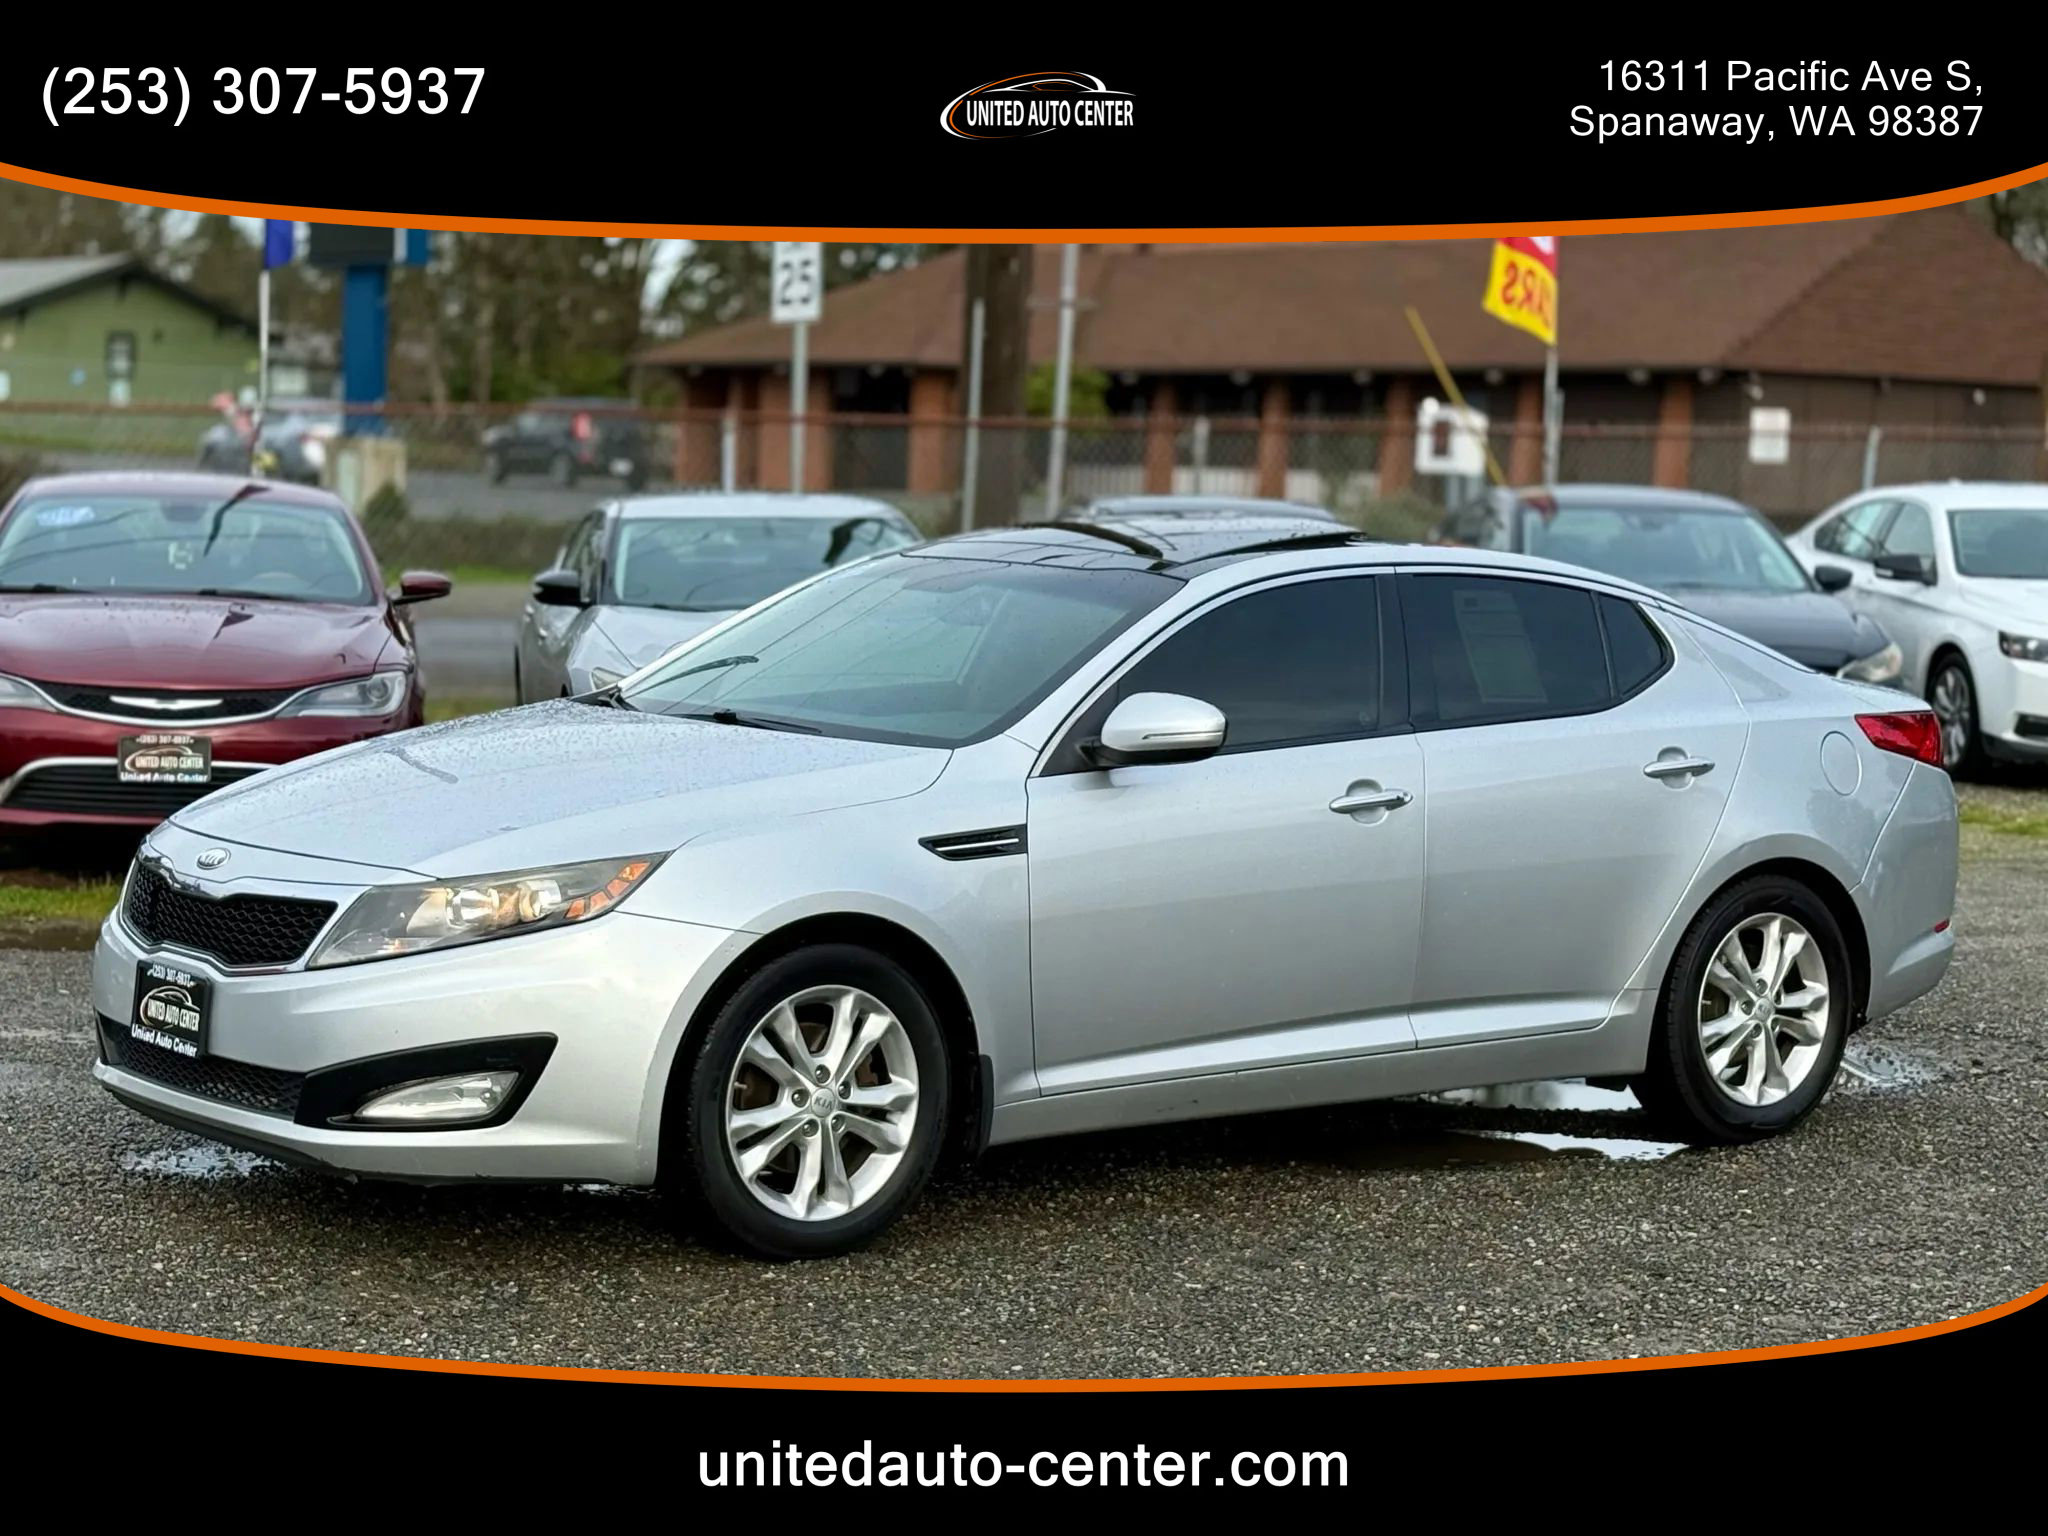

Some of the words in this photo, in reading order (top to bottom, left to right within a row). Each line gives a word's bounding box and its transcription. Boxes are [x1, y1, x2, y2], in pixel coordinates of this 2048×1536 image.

[779, 259, 817, 307] 25
[160, 755, 178, 769] AUTO
[179, 756, 204, 769] CENTER
[147, 998, 166, 1021] UNITED
[165, 1004, 180, 1026] AUTO
[179, 1008, 200, 1032] CENTER
[131, 1022, 156, 1044] United
[155, 1031, 173, 1049] Auto
[173, 1037, 198, 1057] Center
